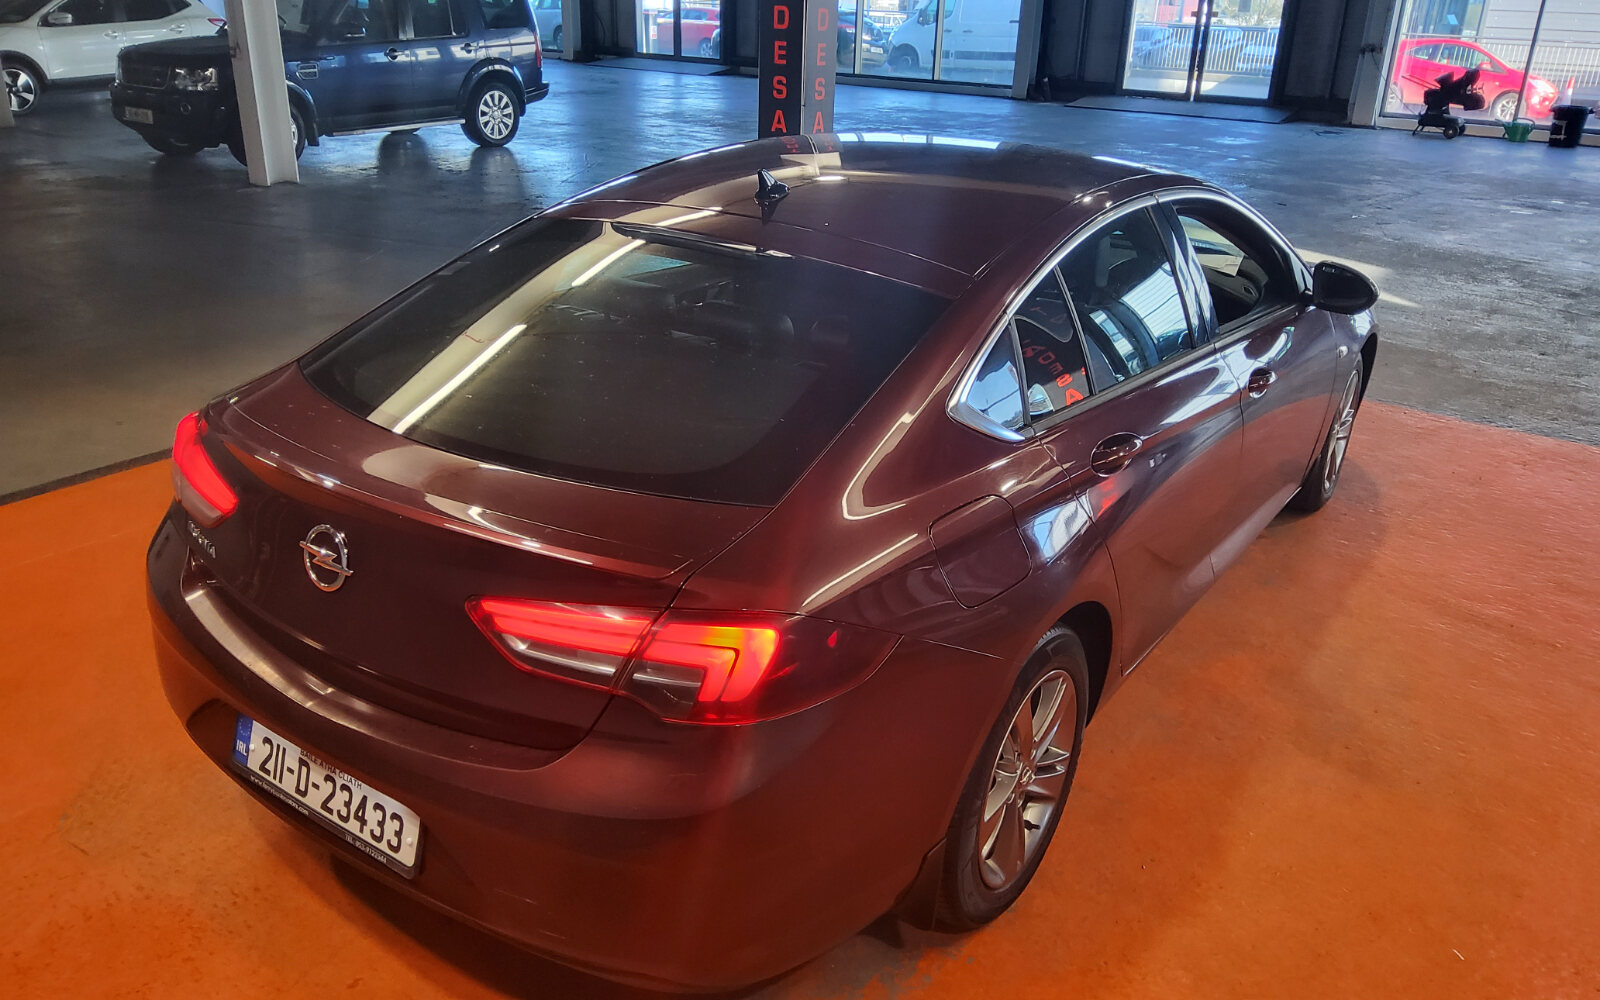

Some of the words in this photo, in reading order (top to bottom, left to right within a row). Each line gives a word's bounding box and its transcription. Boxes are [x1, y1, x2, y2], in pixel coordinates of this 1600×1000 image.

[235, 739, 248, 756] IRL
[300, 750, 319, 764] BAILE
[338, 771, 362, 790] CLIATH
[258, 736, 404, 854] 211-D-23433
